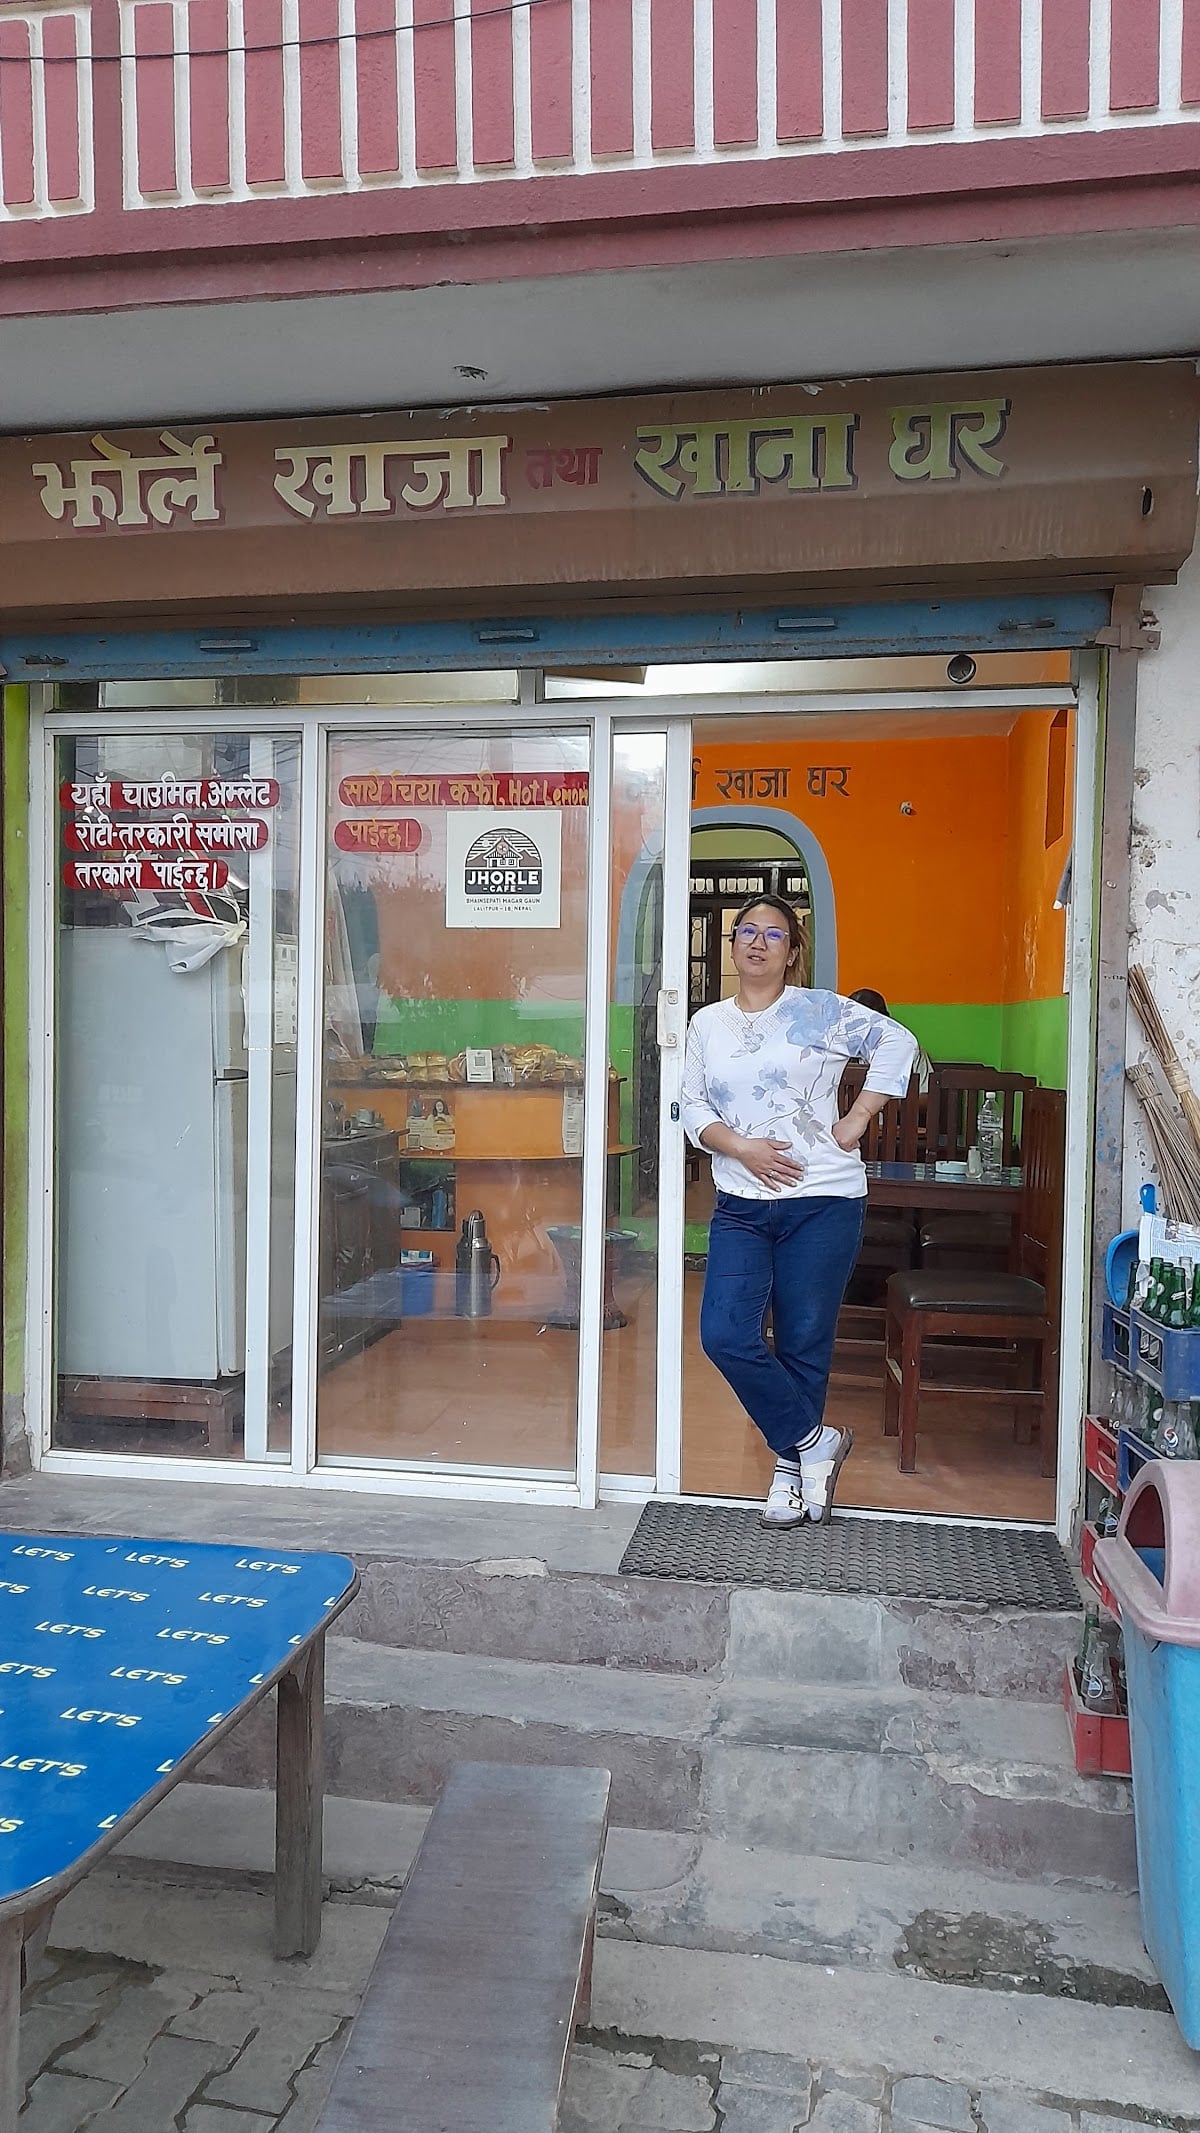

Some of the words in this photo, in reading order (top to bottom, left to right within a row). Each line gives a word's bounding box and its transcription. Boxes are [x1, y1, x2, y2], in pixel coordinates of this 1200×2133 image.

[32, 430, 223, 528] झोर्ले
[273, 435, 511, 519] खाजा
[525, 446, 602, 488] तथा
[634, 412, 858, 499] खाना
[887, 399, 1010, 481] घर
[71, 771, 111, 811] यहाँ
[715, 768, 790, 799] खाजा
[807, 766, 851, 797] घर
[508, 779, 540, 806] Hot
[196, 815, 259, 852] समोसा
[74, 854, 142, 891] तरकारी
[467, 870, 539, 885] JHORLE
[489, 885, 516, 893] CAFE
[11, 1545, 75, 1561] LET'S
[124, 1552, 190, 1569] LET'S
[235, 1558, 302, 1574] LET'S
[82, 1585, 151, 1602] LET'S
[198, 1592, 268, 1608] LET'S
[34, 1621, 106, 1638] LET'S
[156, 1628, 230, 1645] LET'S
[110, 1666, 188, 1685] LET'S
[59, 1707, 142, 1727] LET'S
[0, 1755, 88, 1777] LET'S
